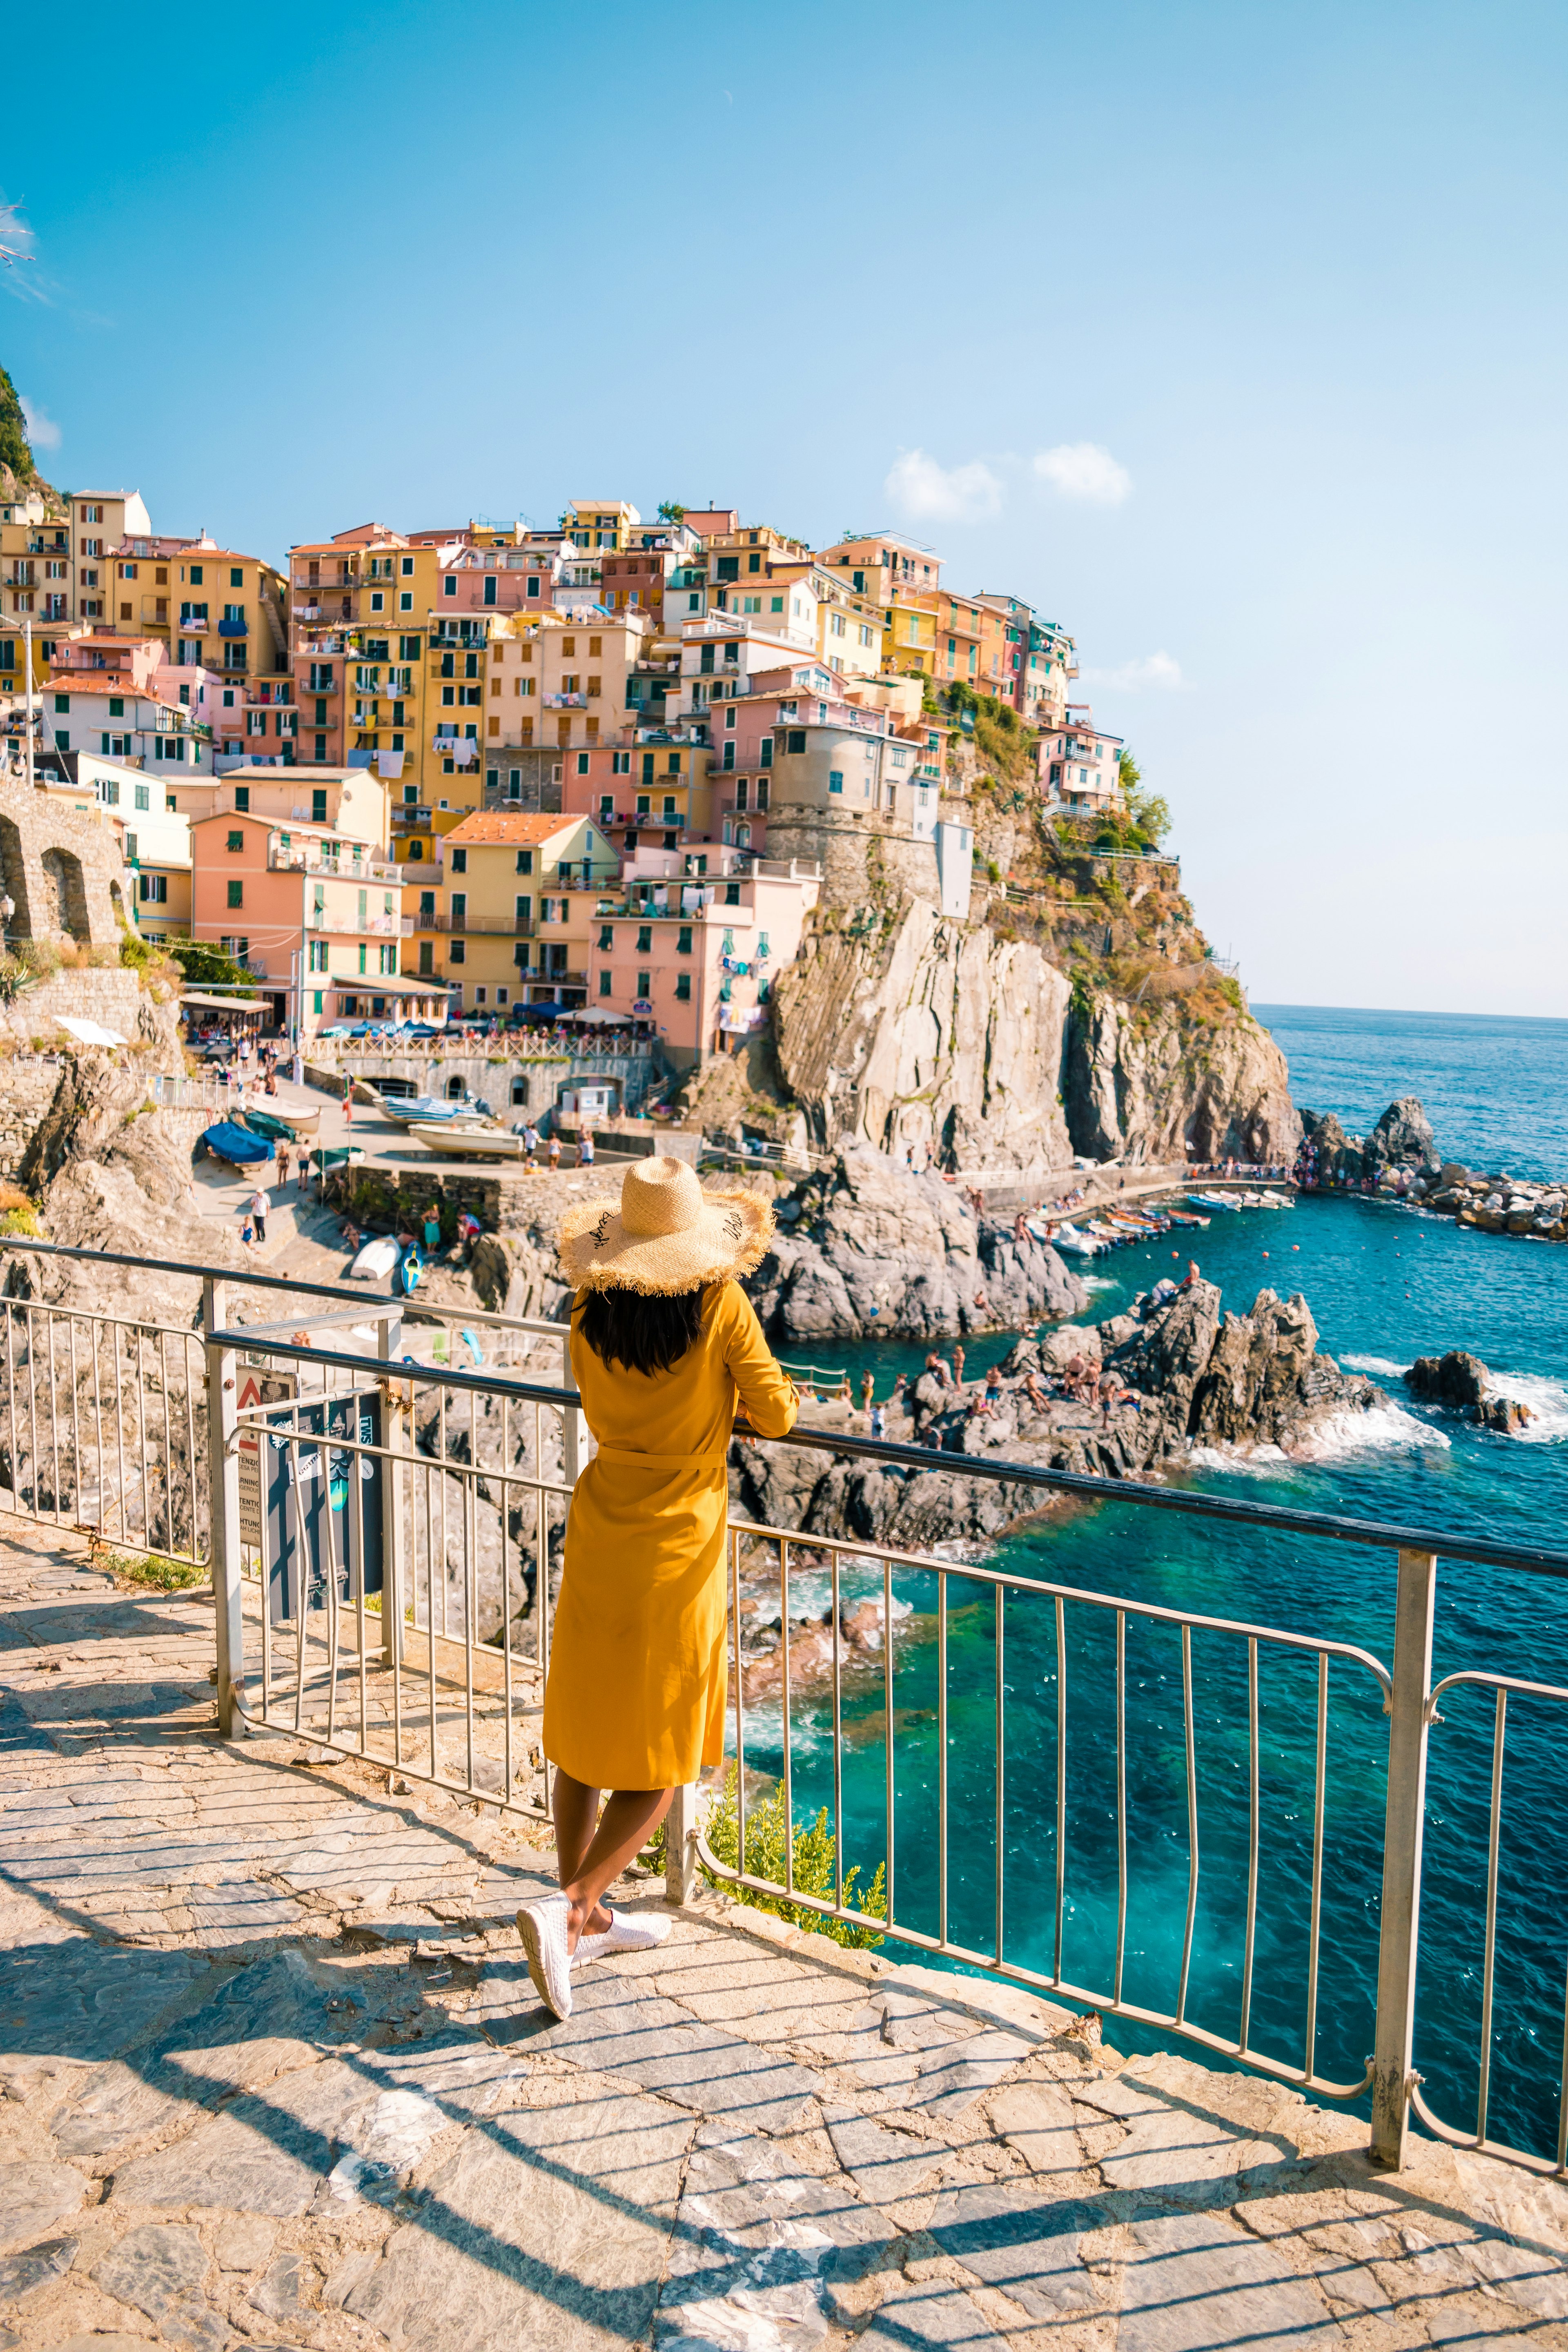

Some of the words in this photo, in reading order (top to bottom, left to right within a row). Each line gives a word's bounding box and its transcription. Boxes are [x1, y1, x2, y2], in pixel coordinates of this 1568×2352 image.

[361, 1418, 371, 1444] TWS
[239, 1477, 259, 1487] RNING
[240, 1505, 255, 1513] CENTE
